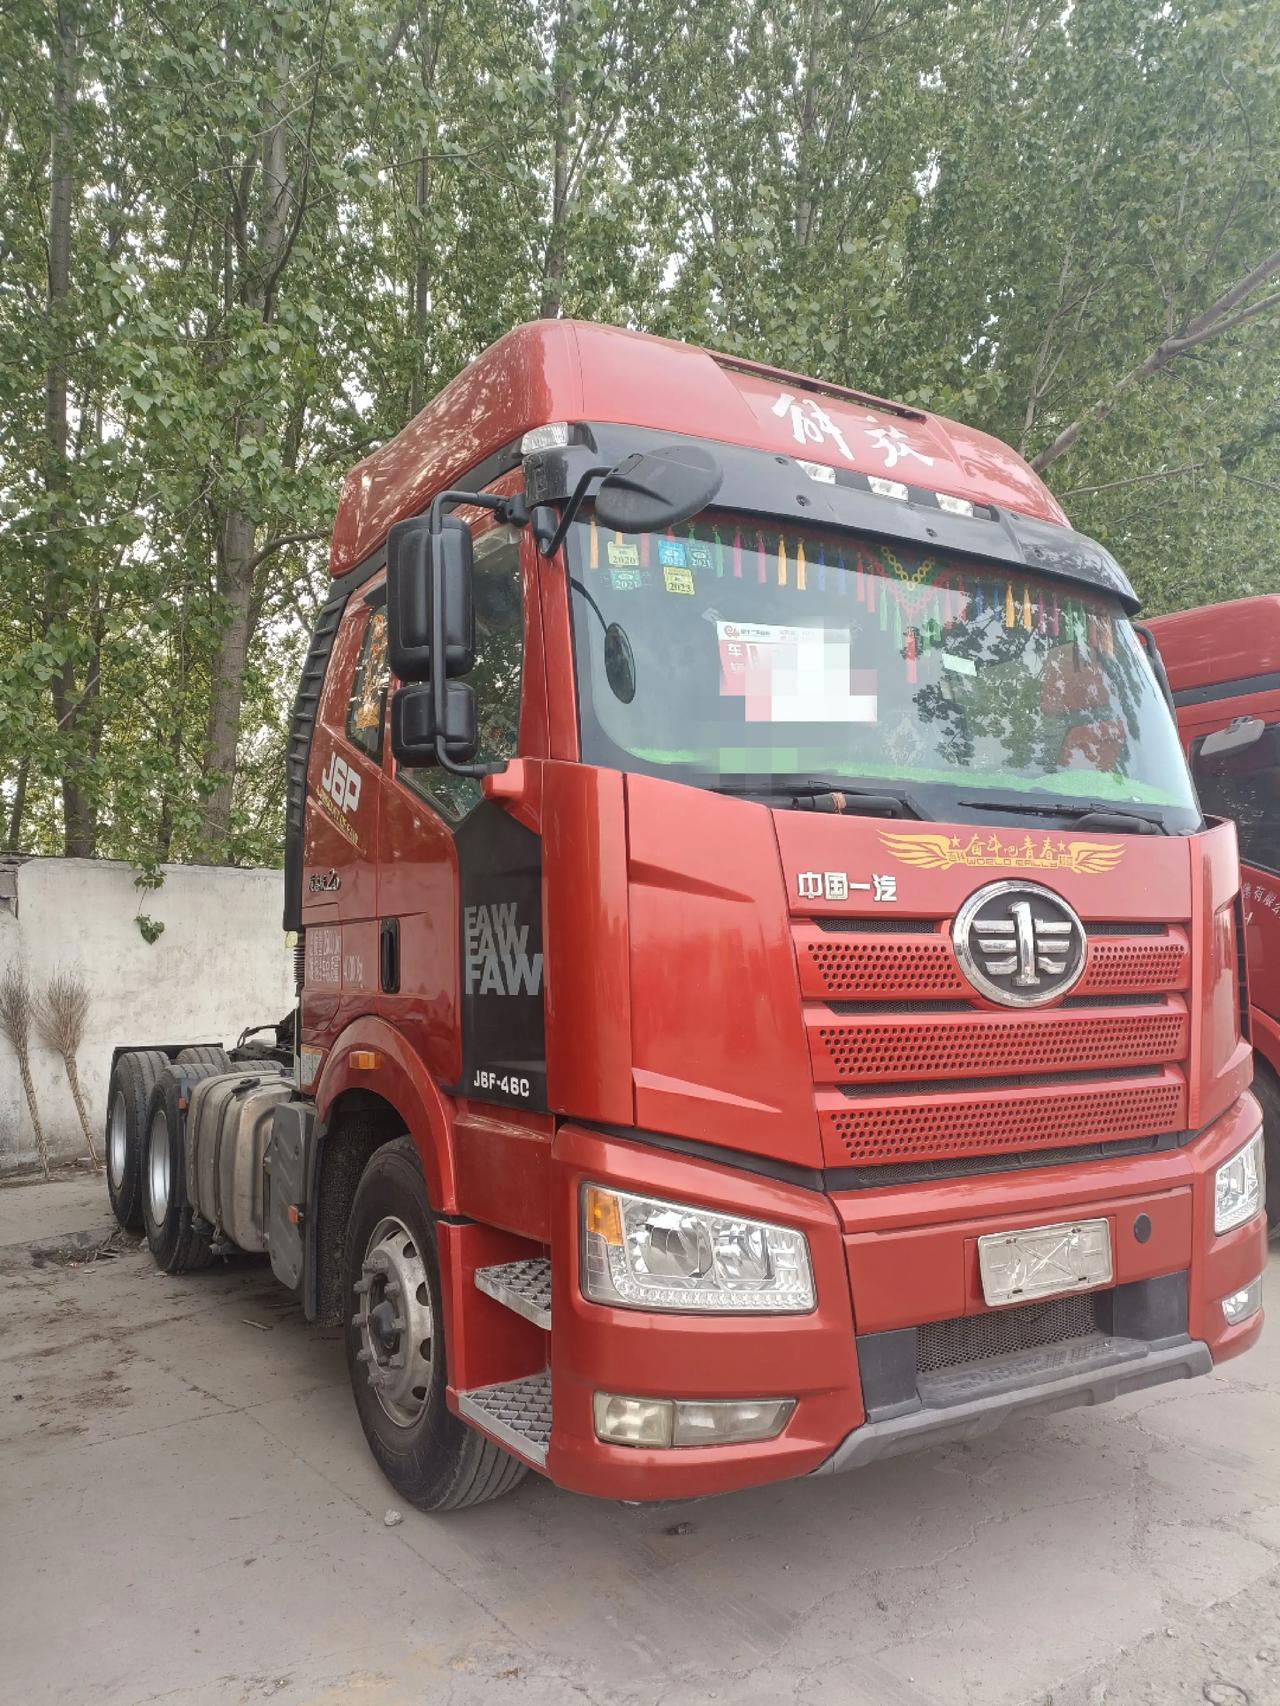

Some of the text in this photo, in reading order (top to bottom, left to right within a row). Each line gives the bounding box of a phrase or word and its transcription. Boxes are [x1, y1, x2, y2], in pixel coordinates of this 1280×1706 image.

[321, 750, 362, 815] J6P
[797, 870, 898, 902] 中国一汽
[465, 953, 544, 996] FAW
